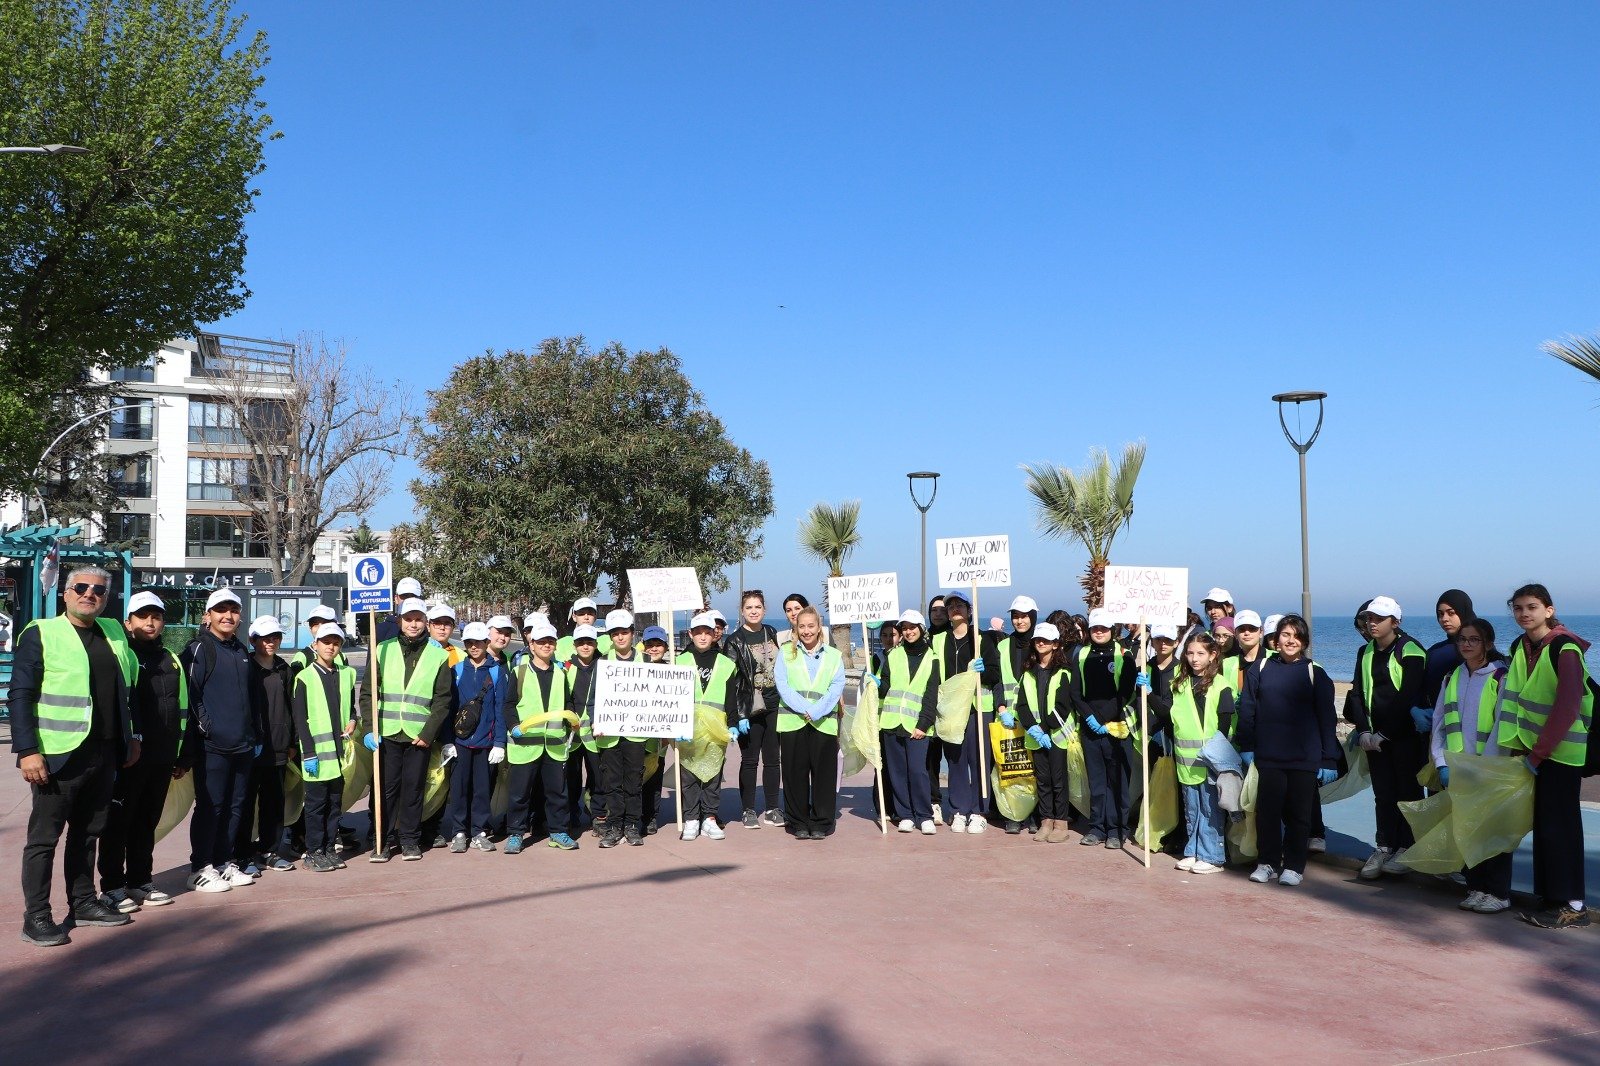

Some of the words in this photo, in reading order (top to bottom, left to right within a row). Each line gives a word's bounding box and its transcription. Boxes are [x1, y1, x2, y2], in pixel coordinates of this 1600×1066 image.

[142, 574, 175, 586] UM
[1112, 569, 1173, 586] KUMSAL
[605, 665, 644, 680] ŞEHİT
[603, 698, 648, 708] ANADOLU
